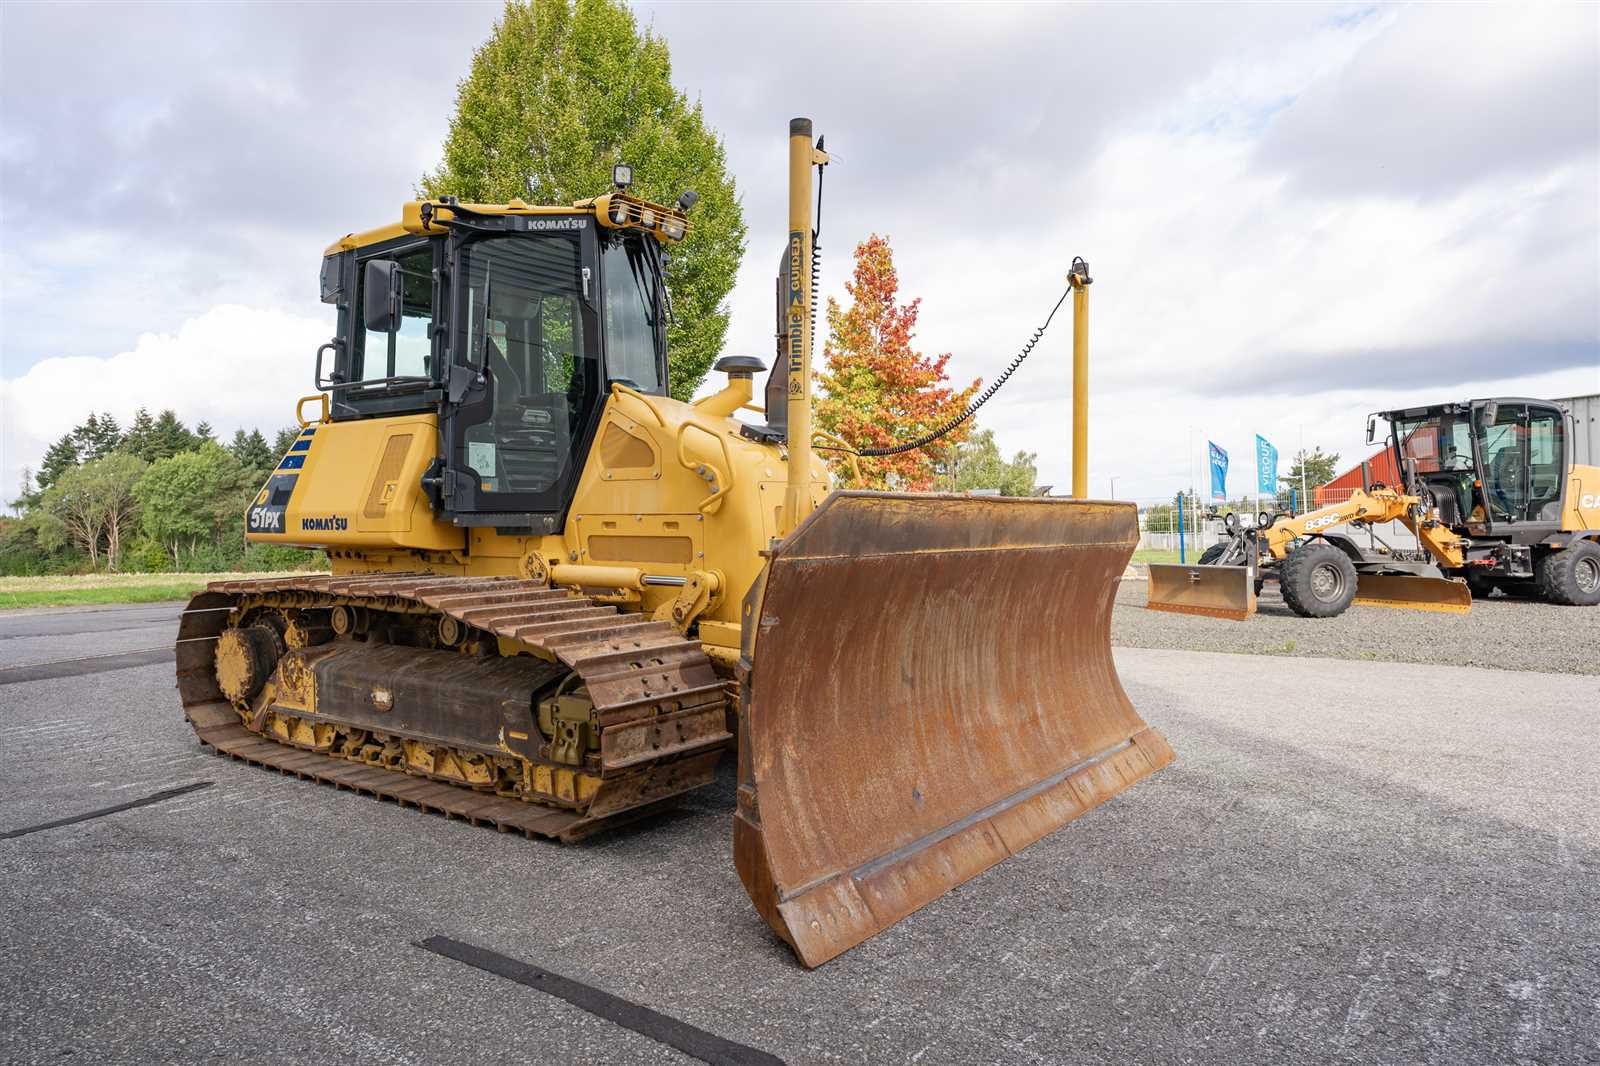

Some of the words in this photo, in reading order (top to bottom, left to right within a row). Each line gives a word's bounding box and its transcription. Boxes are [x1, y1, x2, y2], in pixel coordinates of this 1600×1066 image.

[528, 217, 587, 230] KOMATSU
[790, 237, 802, 291] GUIDED
[788, 313, 803, 375] Trimble
[1261, 440, 1270, 486] VIGOUR
[250, 507, 280, 529] 51PX
[302, 514, 348, 531] KOMATSU
